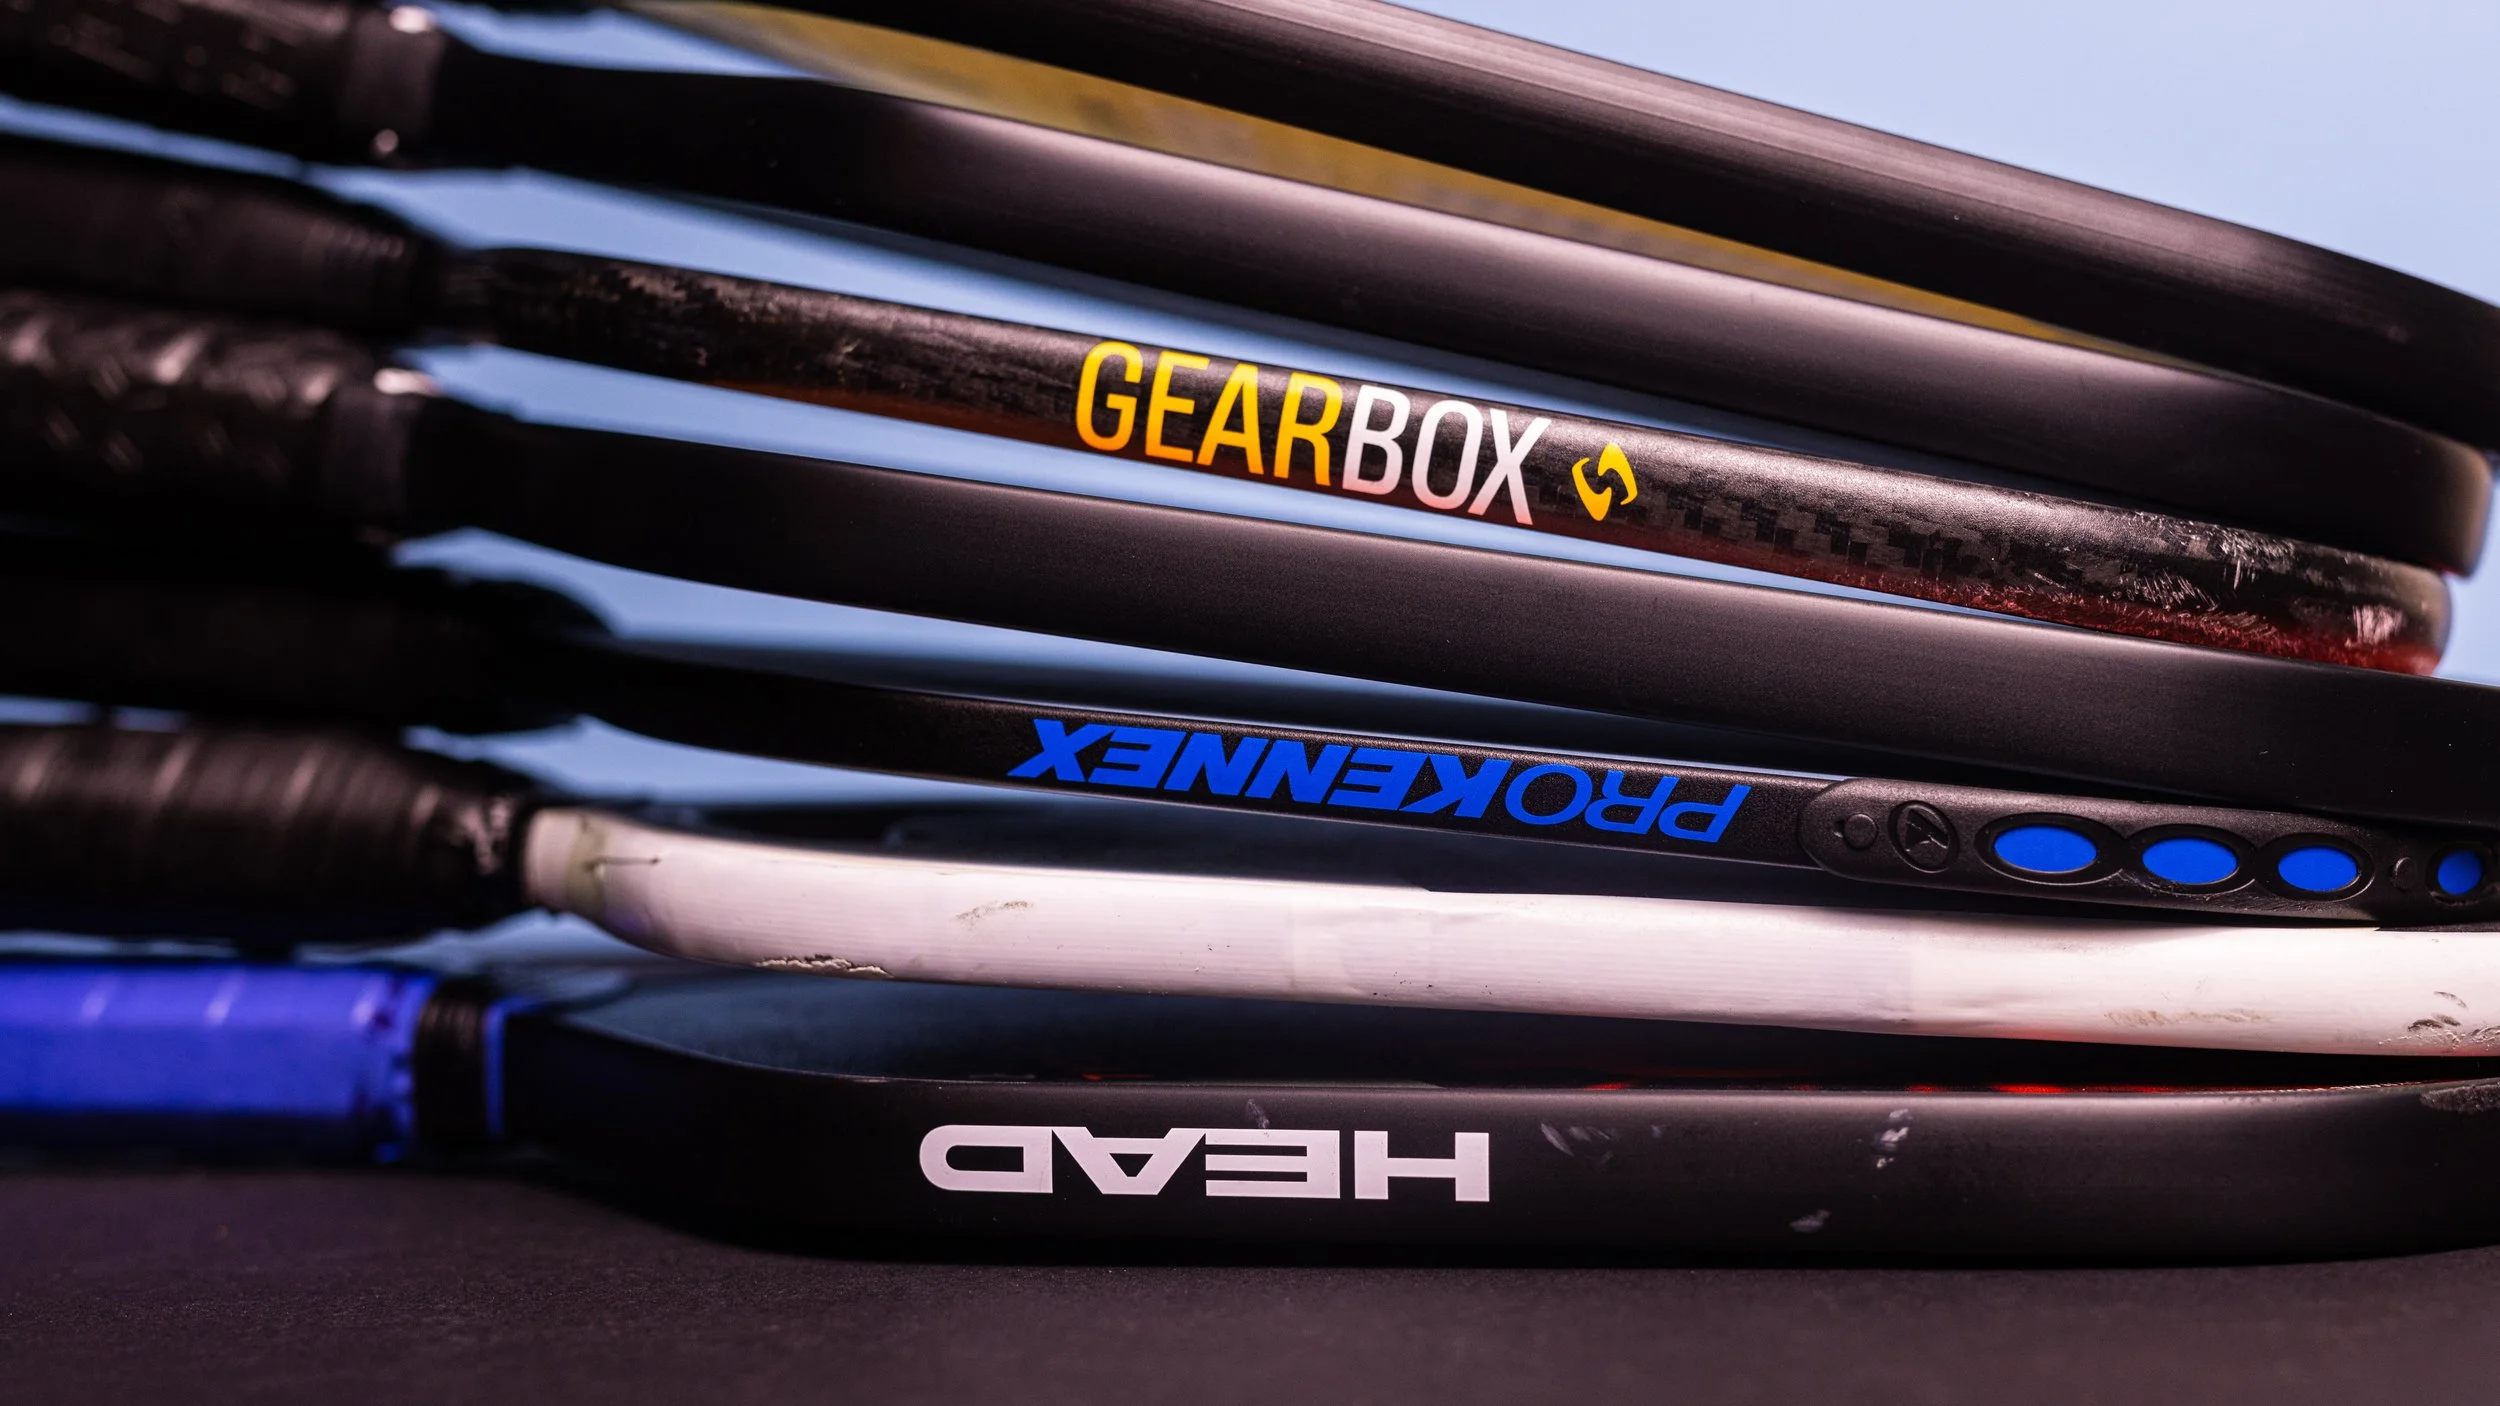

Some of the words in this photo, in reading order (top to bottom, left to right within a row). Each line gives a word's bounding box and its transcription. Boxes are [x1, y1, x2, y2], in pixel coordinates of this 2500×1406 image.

[1076, 340, 1551, 526] GEARBOX
[1008, 718, 1752, 843] PROKENNEX
[919, 1124, 1490, 1203] HEAD
